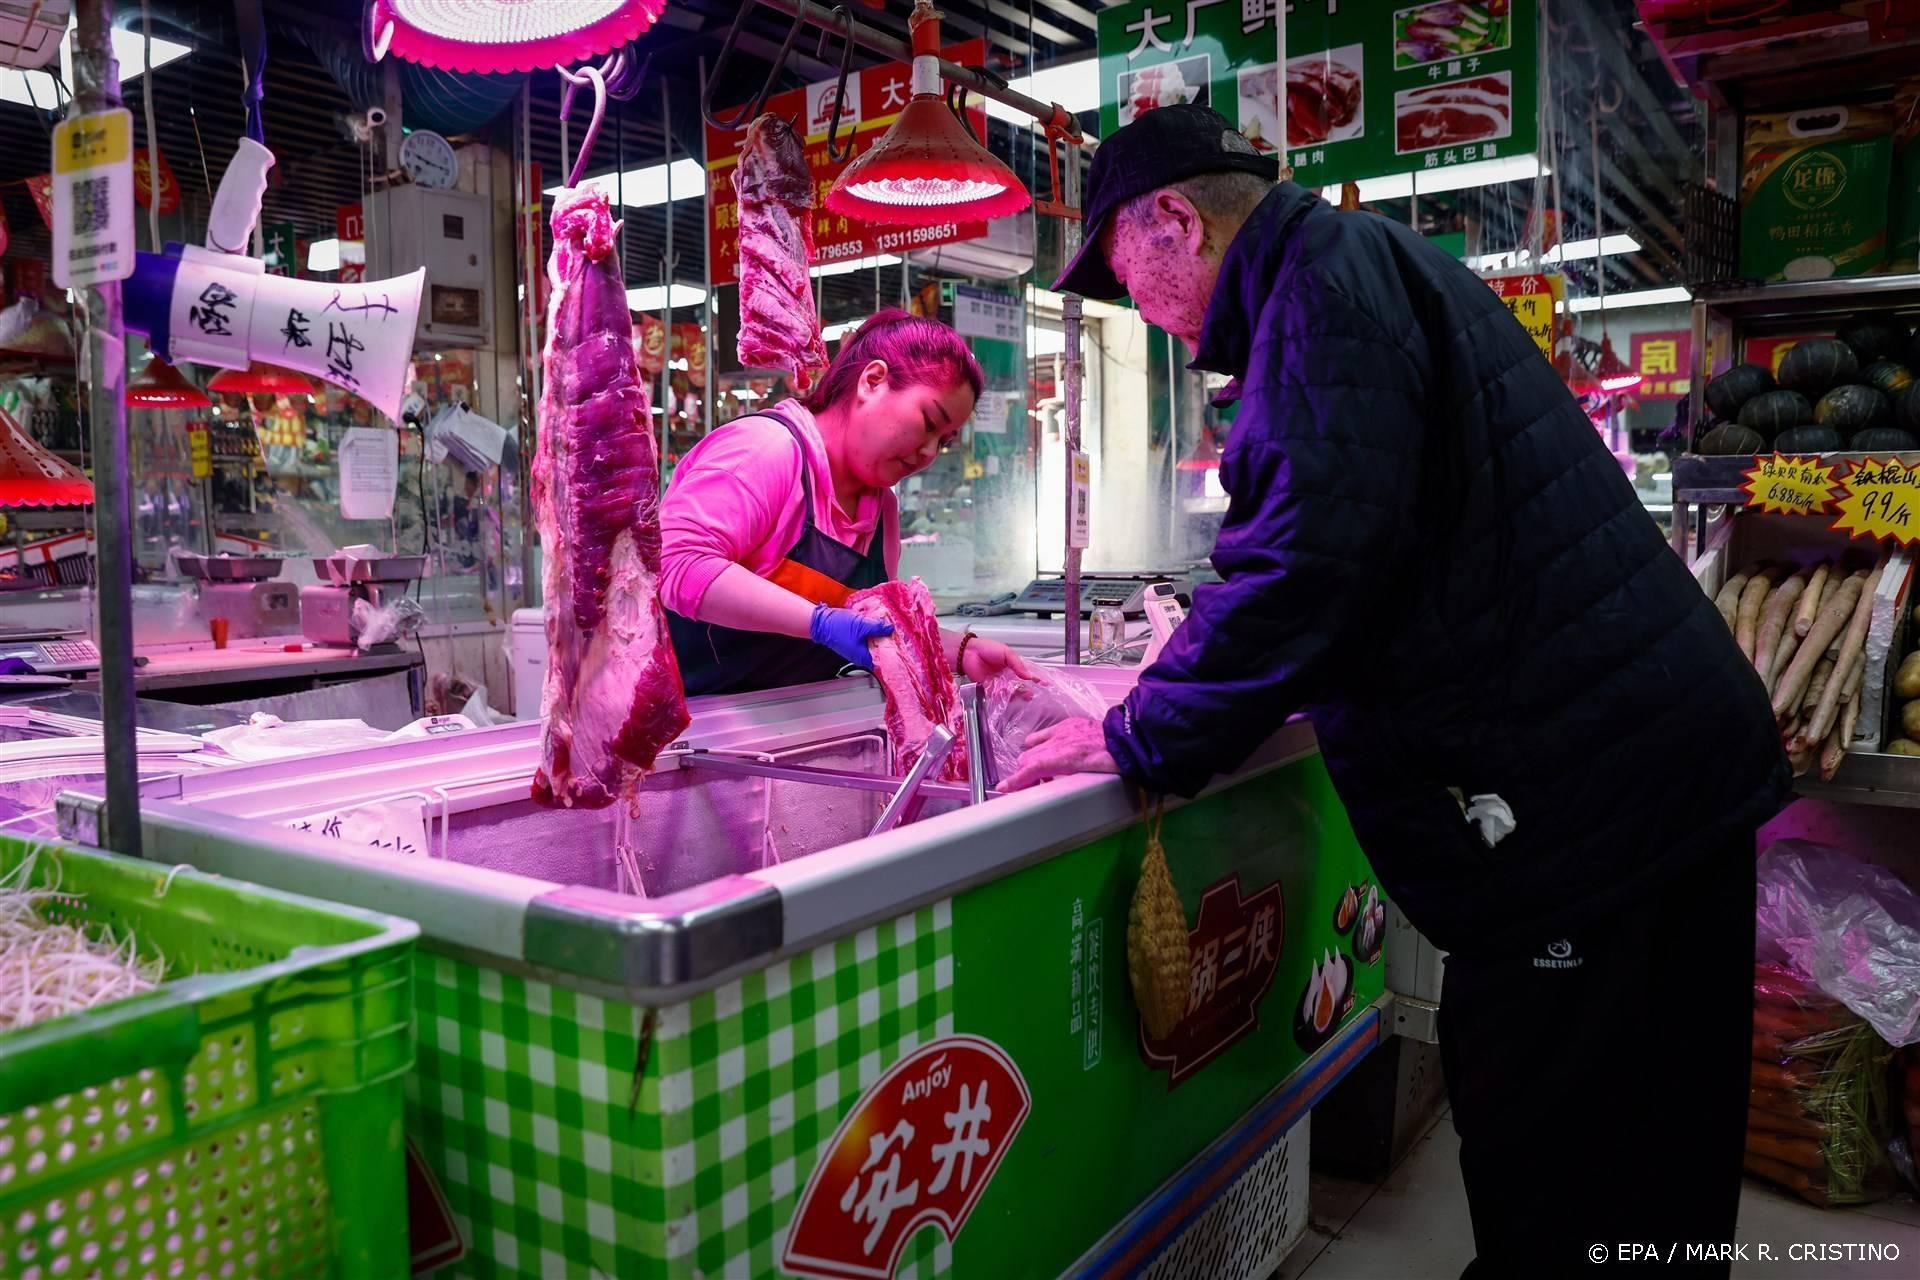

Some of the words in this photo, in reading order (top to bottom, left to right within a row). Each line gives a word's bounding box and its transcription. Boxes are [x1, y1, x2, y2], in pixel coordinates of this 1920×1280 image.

[1428, 57, 1480, 79] 牛腱子
[1424, 143, 1497, 168] 筋头巴脑
[876, 224, 958, 249] 13311598651
[1852, 465, 1920, 489] 铁棍山
[1862, 490, 1912, 526] 9.9/斤
[1070, 897, 1084, 1035] 高端新品
[902, 1059, 952, 1105] Anjoy
[839, 1080, 992, 1256] 安井
